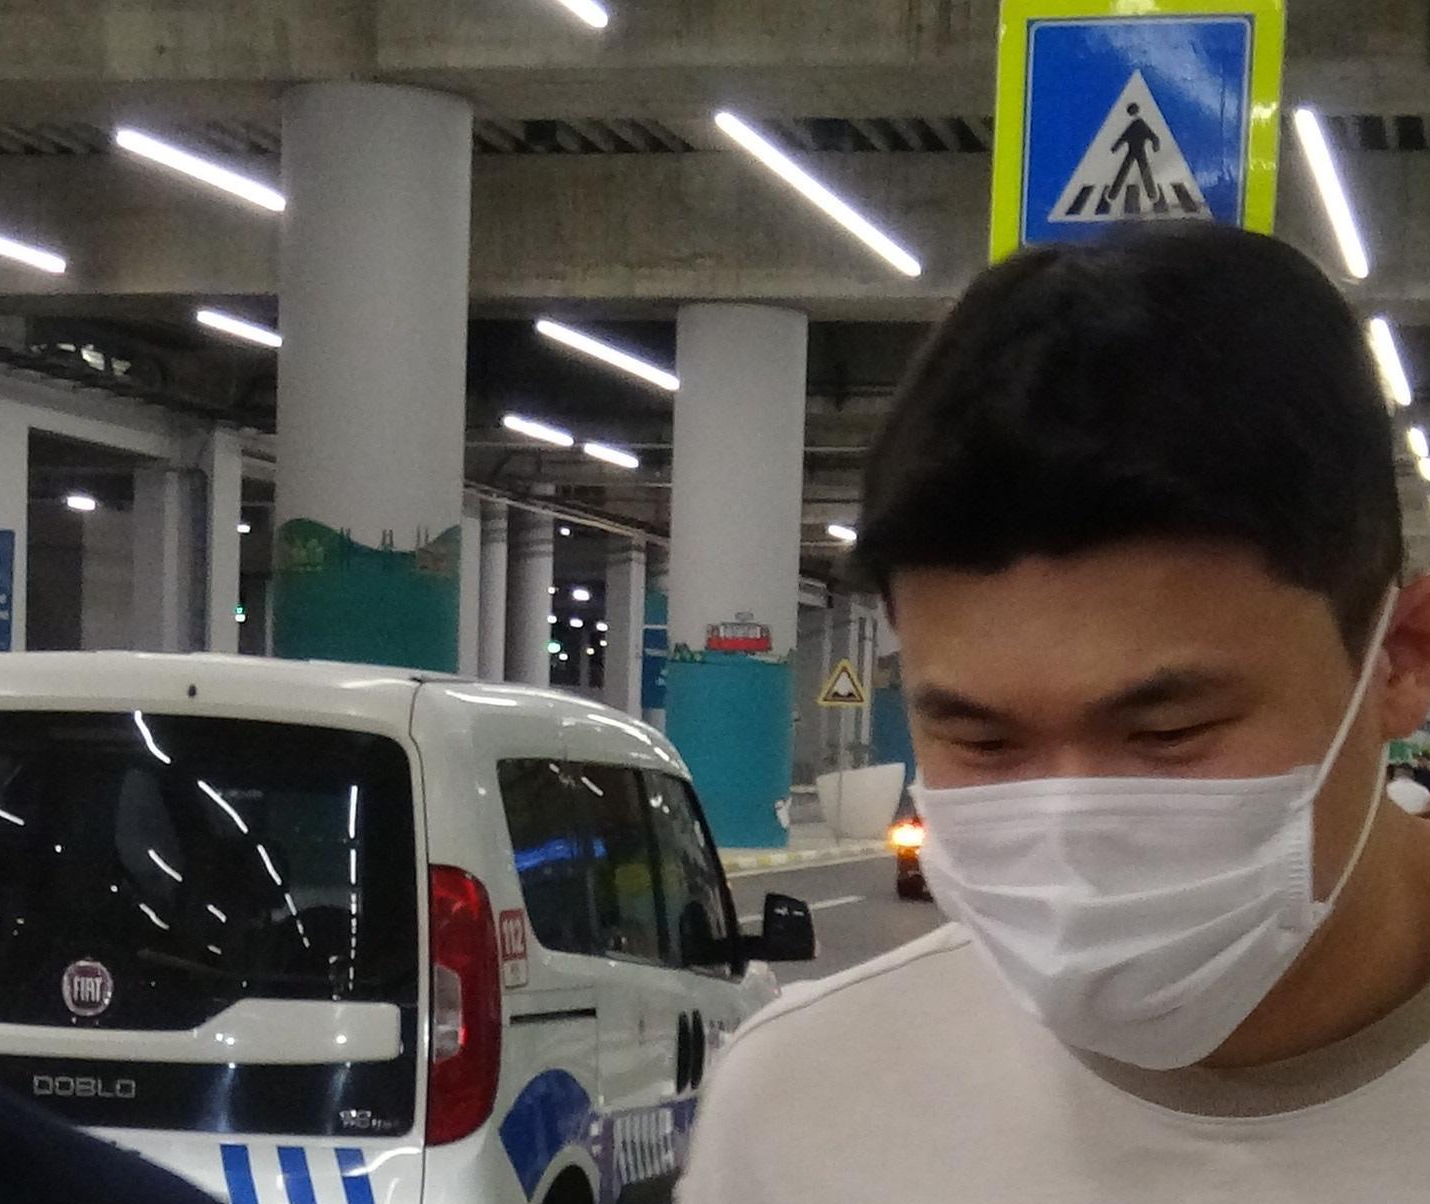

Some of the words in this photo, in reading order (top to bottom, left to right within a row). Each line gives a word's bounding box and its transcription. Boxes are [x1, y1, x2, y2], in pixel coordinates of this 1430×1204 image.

[502, 918, 525, 955] 112
[73, 976, 103, 1002] FIAT
[32, 1074, 137, 1099] DOBLO
